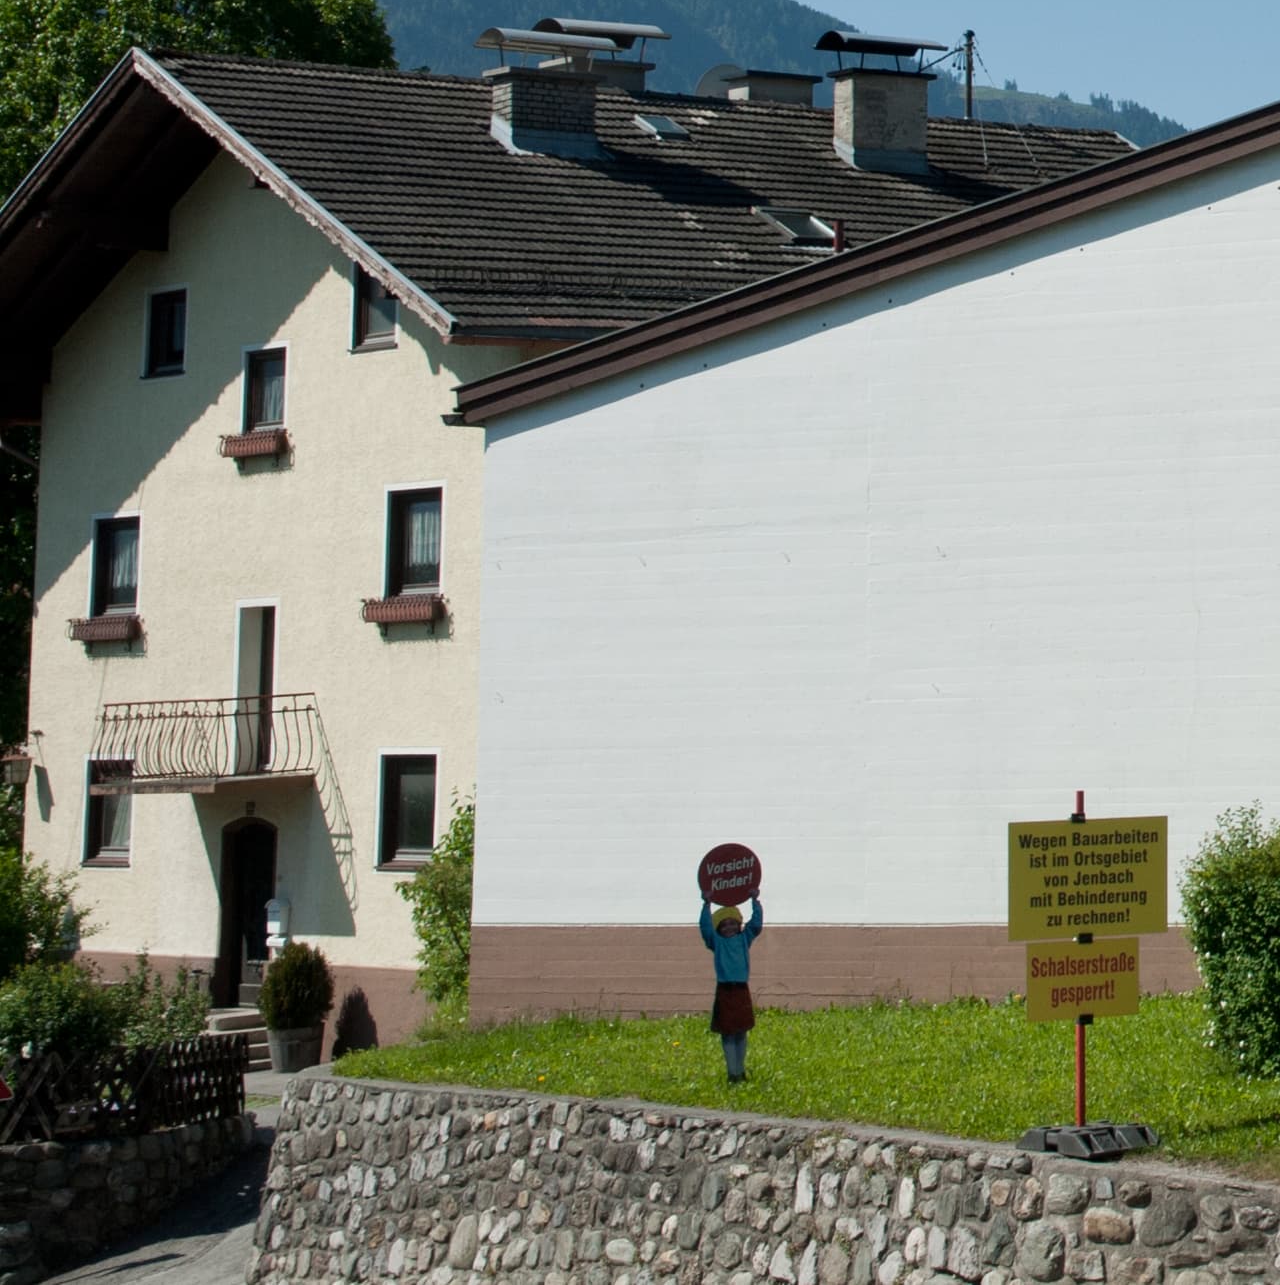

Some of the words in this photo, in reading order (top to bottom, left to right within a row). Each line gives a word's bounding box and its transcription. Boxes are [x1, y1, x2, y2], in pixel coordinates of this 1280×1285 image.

[1019, 835, 1066, 851] Wegen
[1072, 830, 1158, 846] Bauarbeiten
[707, 856, 754, 875] Vorsicht
[1030, 854, 1047, 868] ist
[1053, 853, 1069, 866] im
[1074, 849, 1148, 866] Ortsgebiet
[712, 873, 752, 891] Kinder!
[1044, 874, 1068, 887] von
[1073, 870, 1133, 886] Jenbach
[1030, 894, 1052, 908] mit
[1058, 889, 1147, 906] Behinderung
[1047, 914, 1061, 927] zu
[1067, 909, 1130, 925] rechnen!
[1032, 952, 1135, 978] Schalserstraße
[1051, 980, 1115, 1007] gesperrt!
